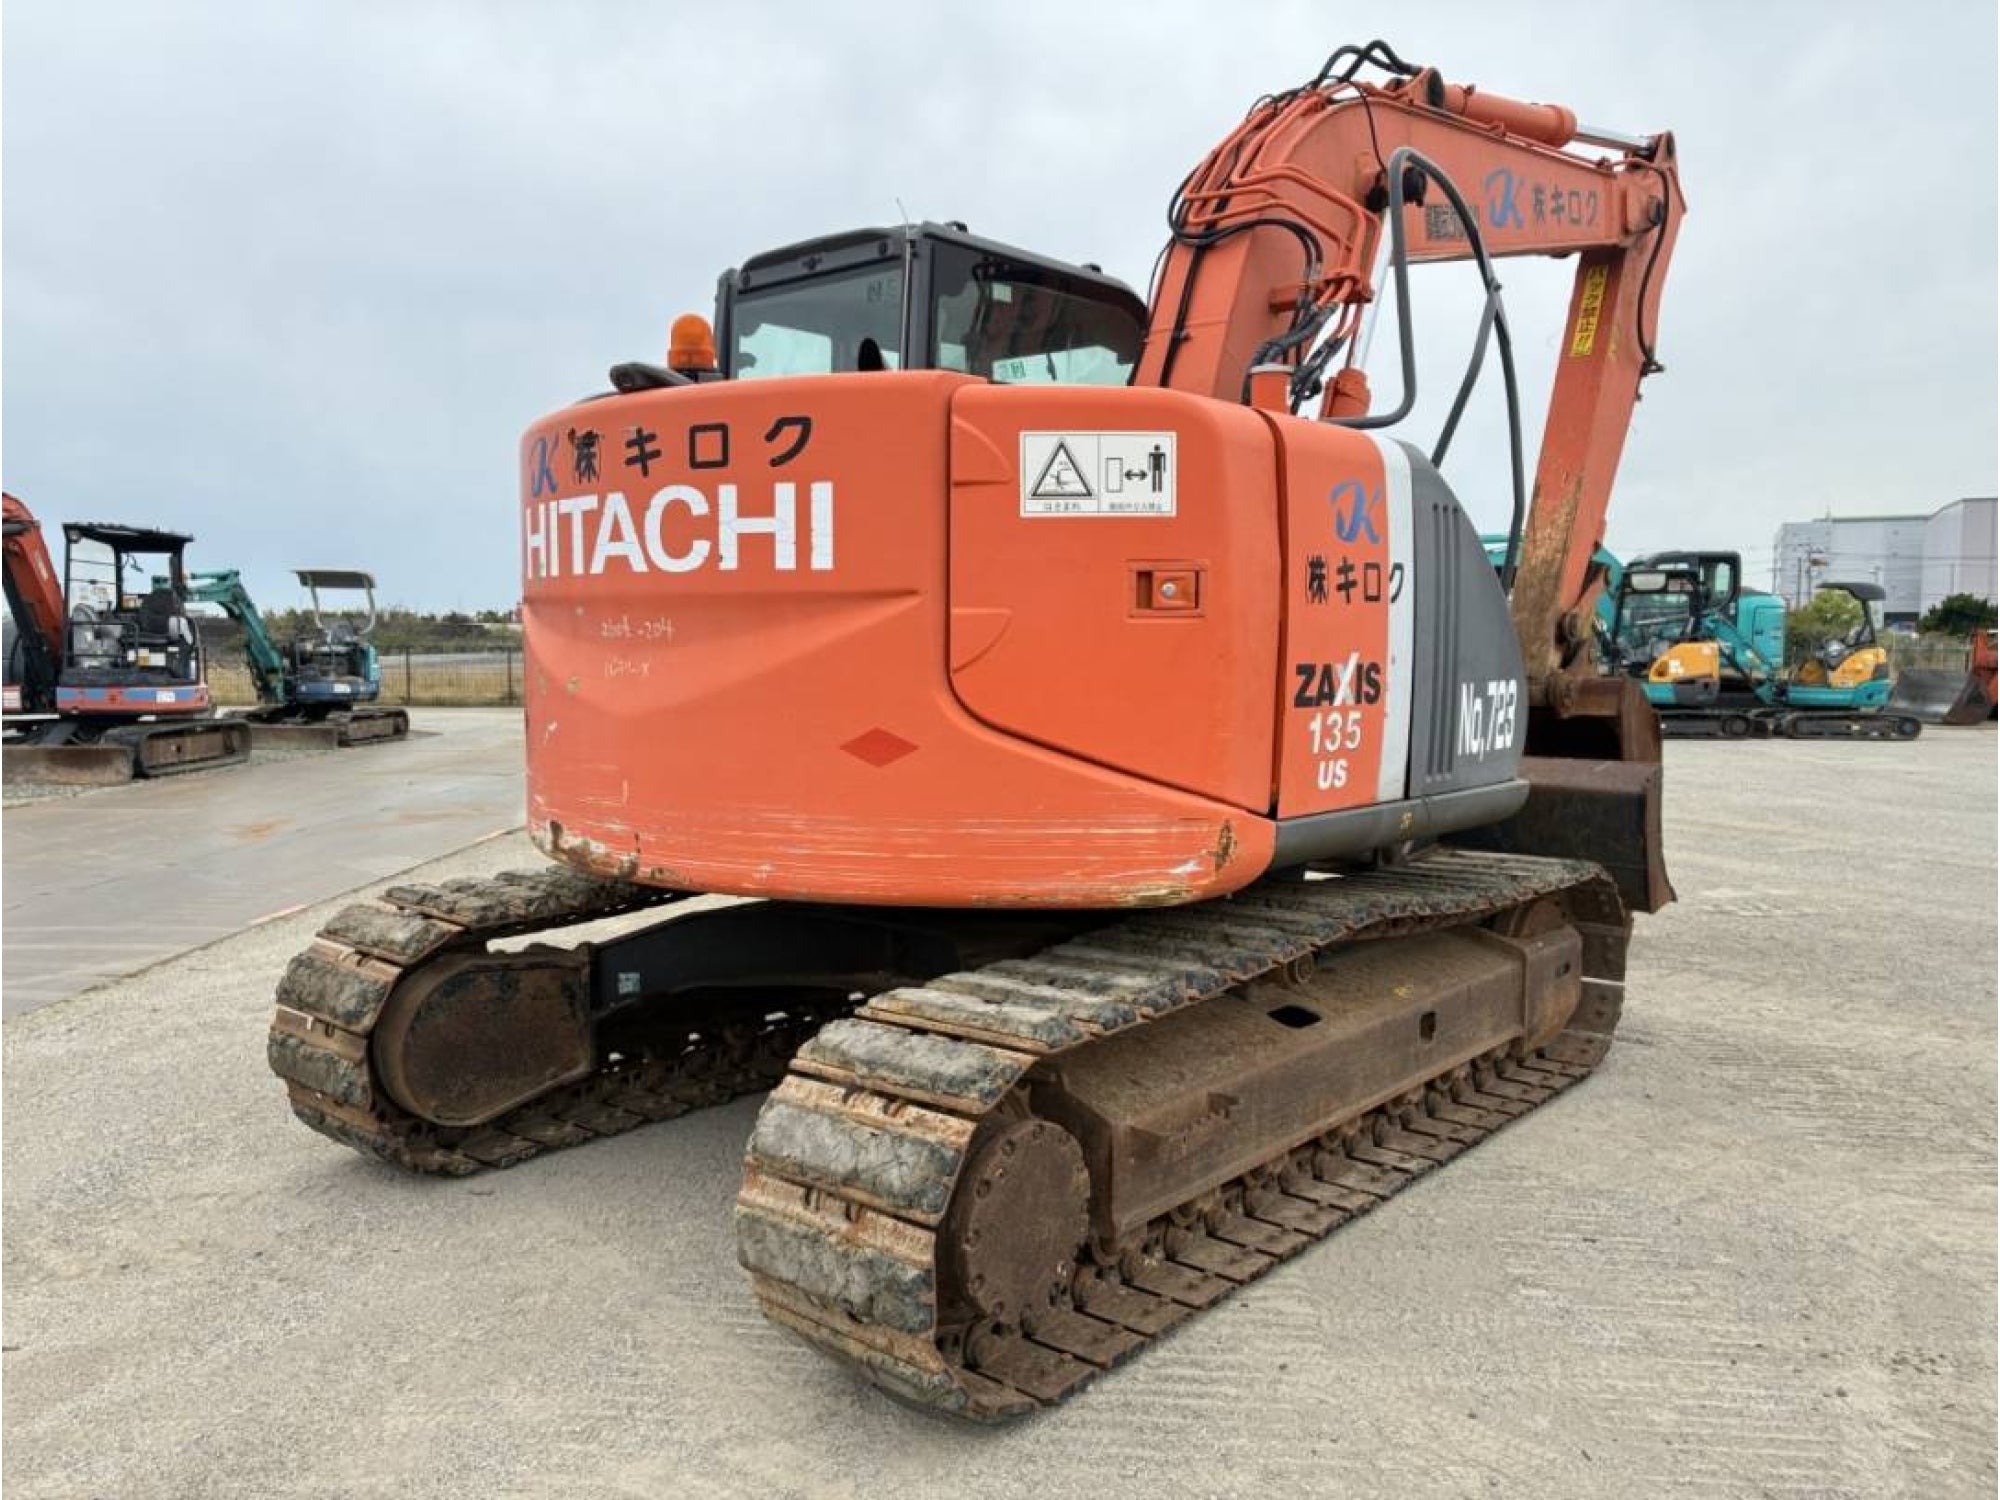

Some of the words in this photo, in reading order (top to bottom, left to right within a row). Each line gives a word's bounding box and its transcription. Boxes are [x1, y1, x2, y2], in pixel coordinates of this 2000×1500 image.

[526, 481, 834, 580] HITACHI
[1294, 651, 1381, 708] ZAXIS
[1309, 710, 1362, 754] 135
[1317, 758, 1349, 790] US
